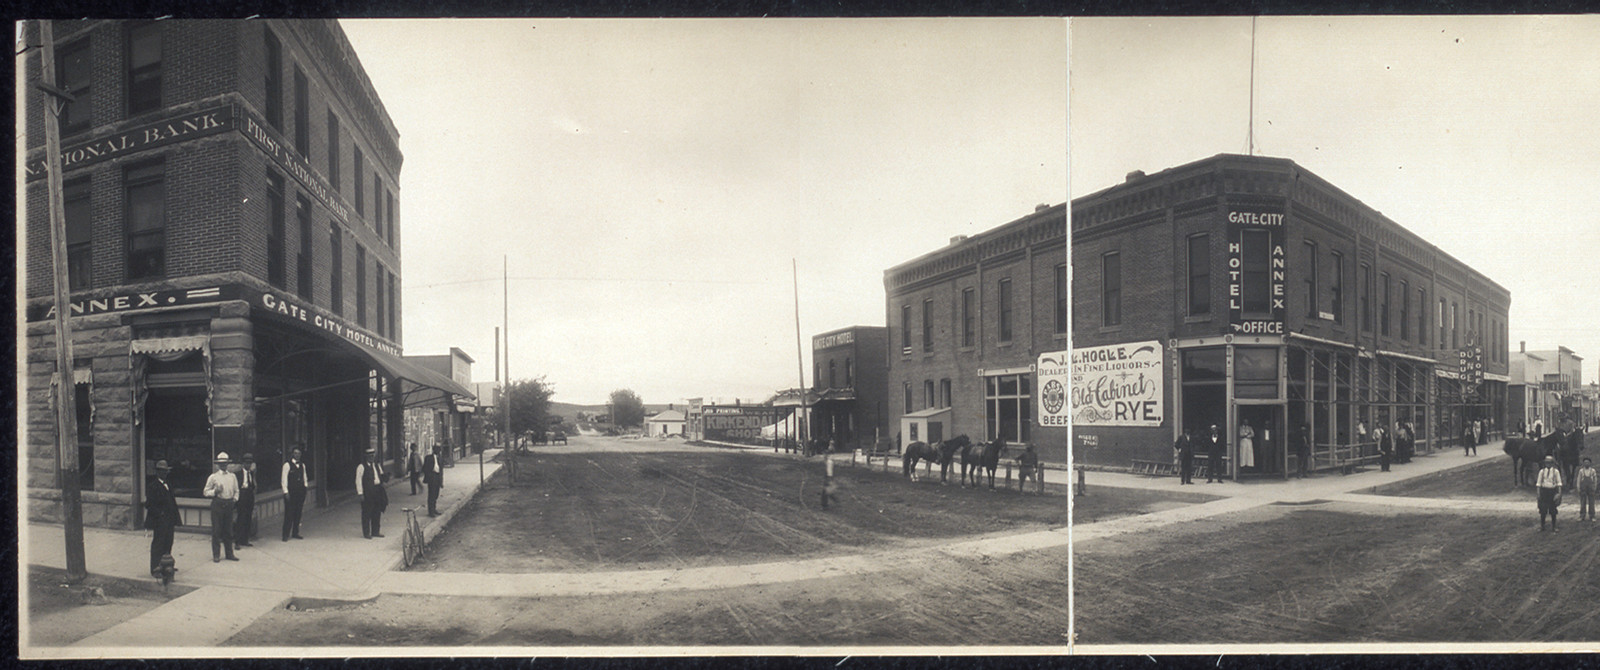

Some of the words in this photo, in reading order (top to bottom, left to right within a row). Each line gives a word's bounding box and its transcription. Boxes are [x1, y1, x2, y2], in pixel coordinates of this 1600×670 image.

[25, 135, 135, 176] NAIONAL
[143, 112, 226, 145] BANK.
[247, 117, 281, 157] FIRST
[285, 152, 328, 203] NATIONAL
[330, 196, 349, 222] BANK
[1228, 211, 1260, 225] GATE
[1260, 213, 1284, 226] CITY
[1229, 243, 1240, 310] HOTEL
[1273, 245, 1284, 309] ANNEX
[262, 293, 307, 321] GATE
[314, 315, 342, 334] CITY
[346, 328, 375, 347] HOTEL
[1242, 321, 1283, 334] OFFICE
[1083, 363, 1104, 372] FINE
[1114, 400, 1162, 421] RYE.
